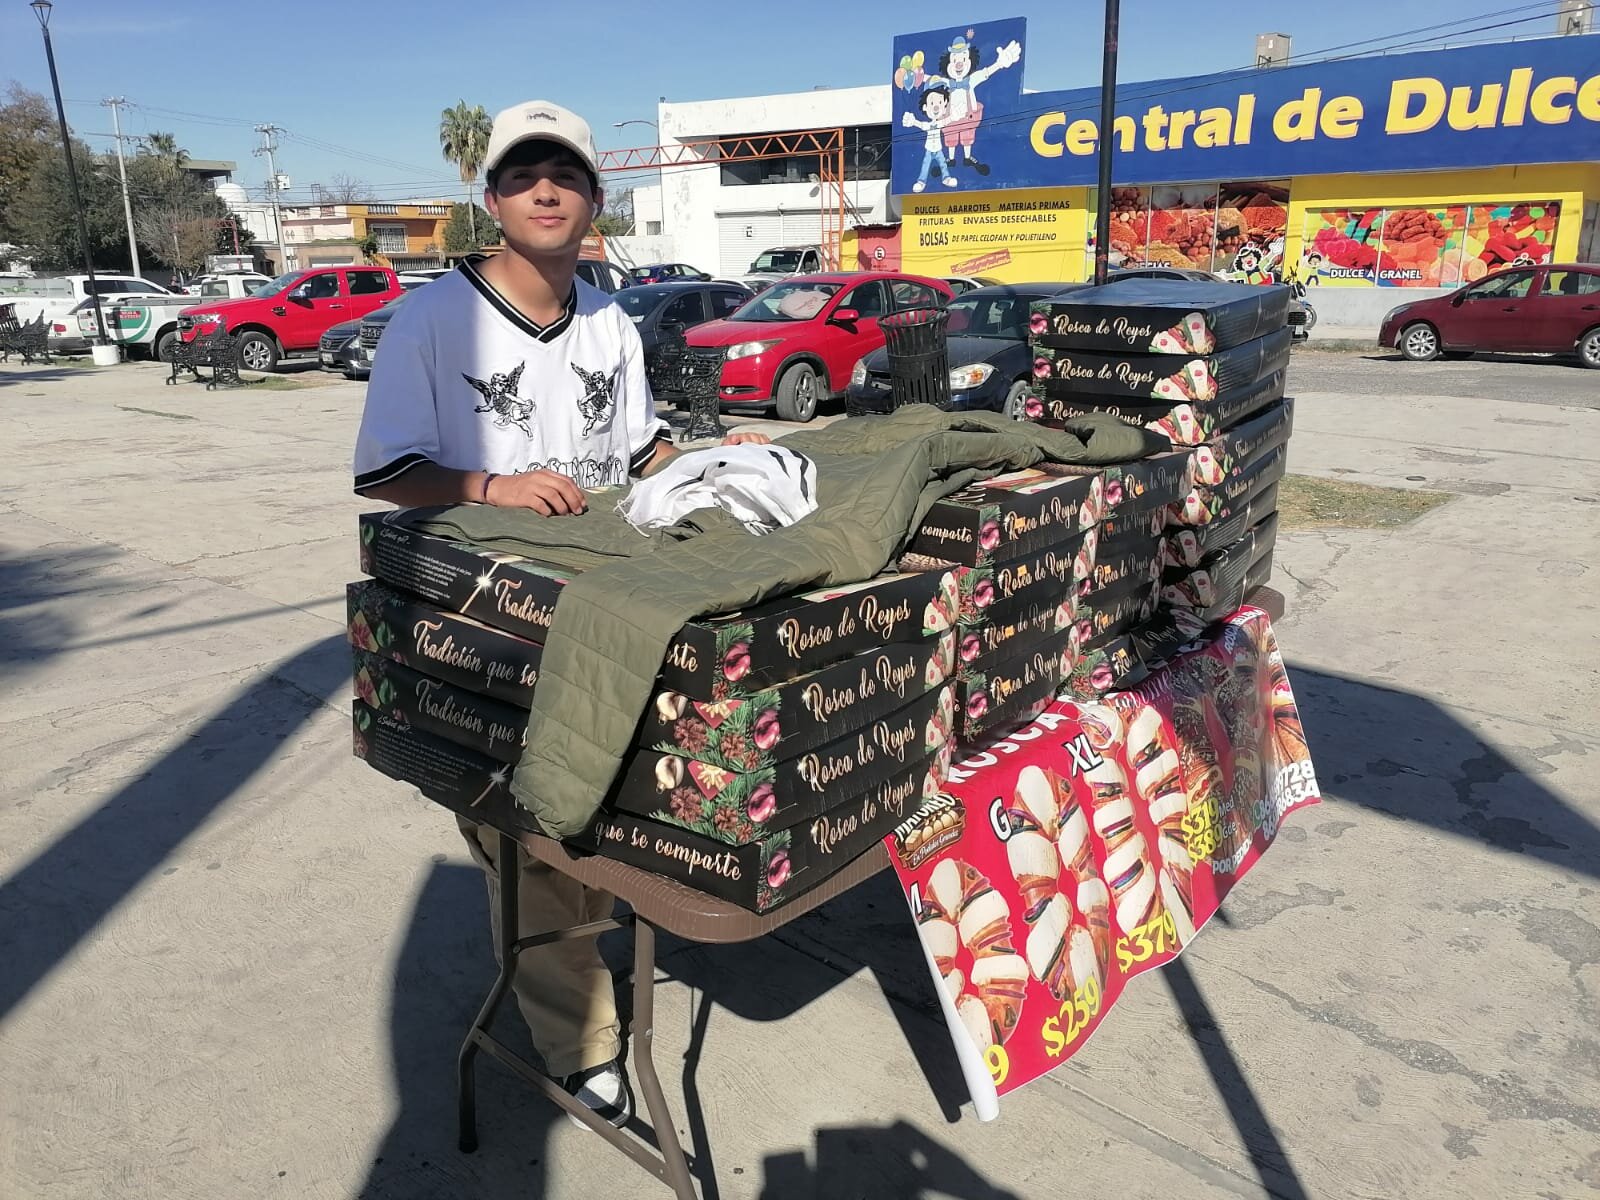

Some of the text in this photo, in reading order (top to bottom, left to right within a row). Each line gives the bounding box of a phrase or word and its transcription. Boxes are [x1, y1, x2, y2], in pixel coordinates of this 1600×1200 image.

[1030, 94, 1256, 158] Central
[1272, 87, 1364, 139] de
[914, 200, 1070, 214] DULCES ABARROTES MATERIAS PRIMAS
[919, 213, 1057, 226] FRITURAS ENVASES DESECHABLES
[919, 231, 949, 247] BOLSAS
[952, 234, 960, 243] DE
[960, 234, 979, 242] PAPEL
[1010, 233, 1015, 241] Y
[1329, 268, 1422, 279] DULCE A GRANEL
[1053, 313, 1152, 345] Rosca de Reyes
[1056, 358, 1155, 390] Rosca de Reyes
[921, 525, 973, 544] comparte
[1040, 504, 1050, 526] de
[1050, 496, 1078, 529] Reyes
[1035, 559, 1047, 581] de
[1045, 551, 1073, 583] Reyes
[777, 594, 911, 659] Rosca de Reyes
[1029, 602, 1055, 632] Reyes
[413, 620, 537, 688] Tradición que se
[1034, 651, 1058, 682] Reyes
[801, 655, 916, 723] Rosca de Reyes
[416, 678, 484, 734] Tradición
[488, 722, 516, 752] que
[796, 719, 915, 792] Rosca de Reyes
[1061, 732, 1104, 778] XL
[810, 773, 915, 854] Rosca de Reyes
[989, 797, 1012, 841] G
[594, 822, 741, 881] que se comparte
[1115, 910, 1177, 973] $379
[1041, 976, 1101, 1057] $259
